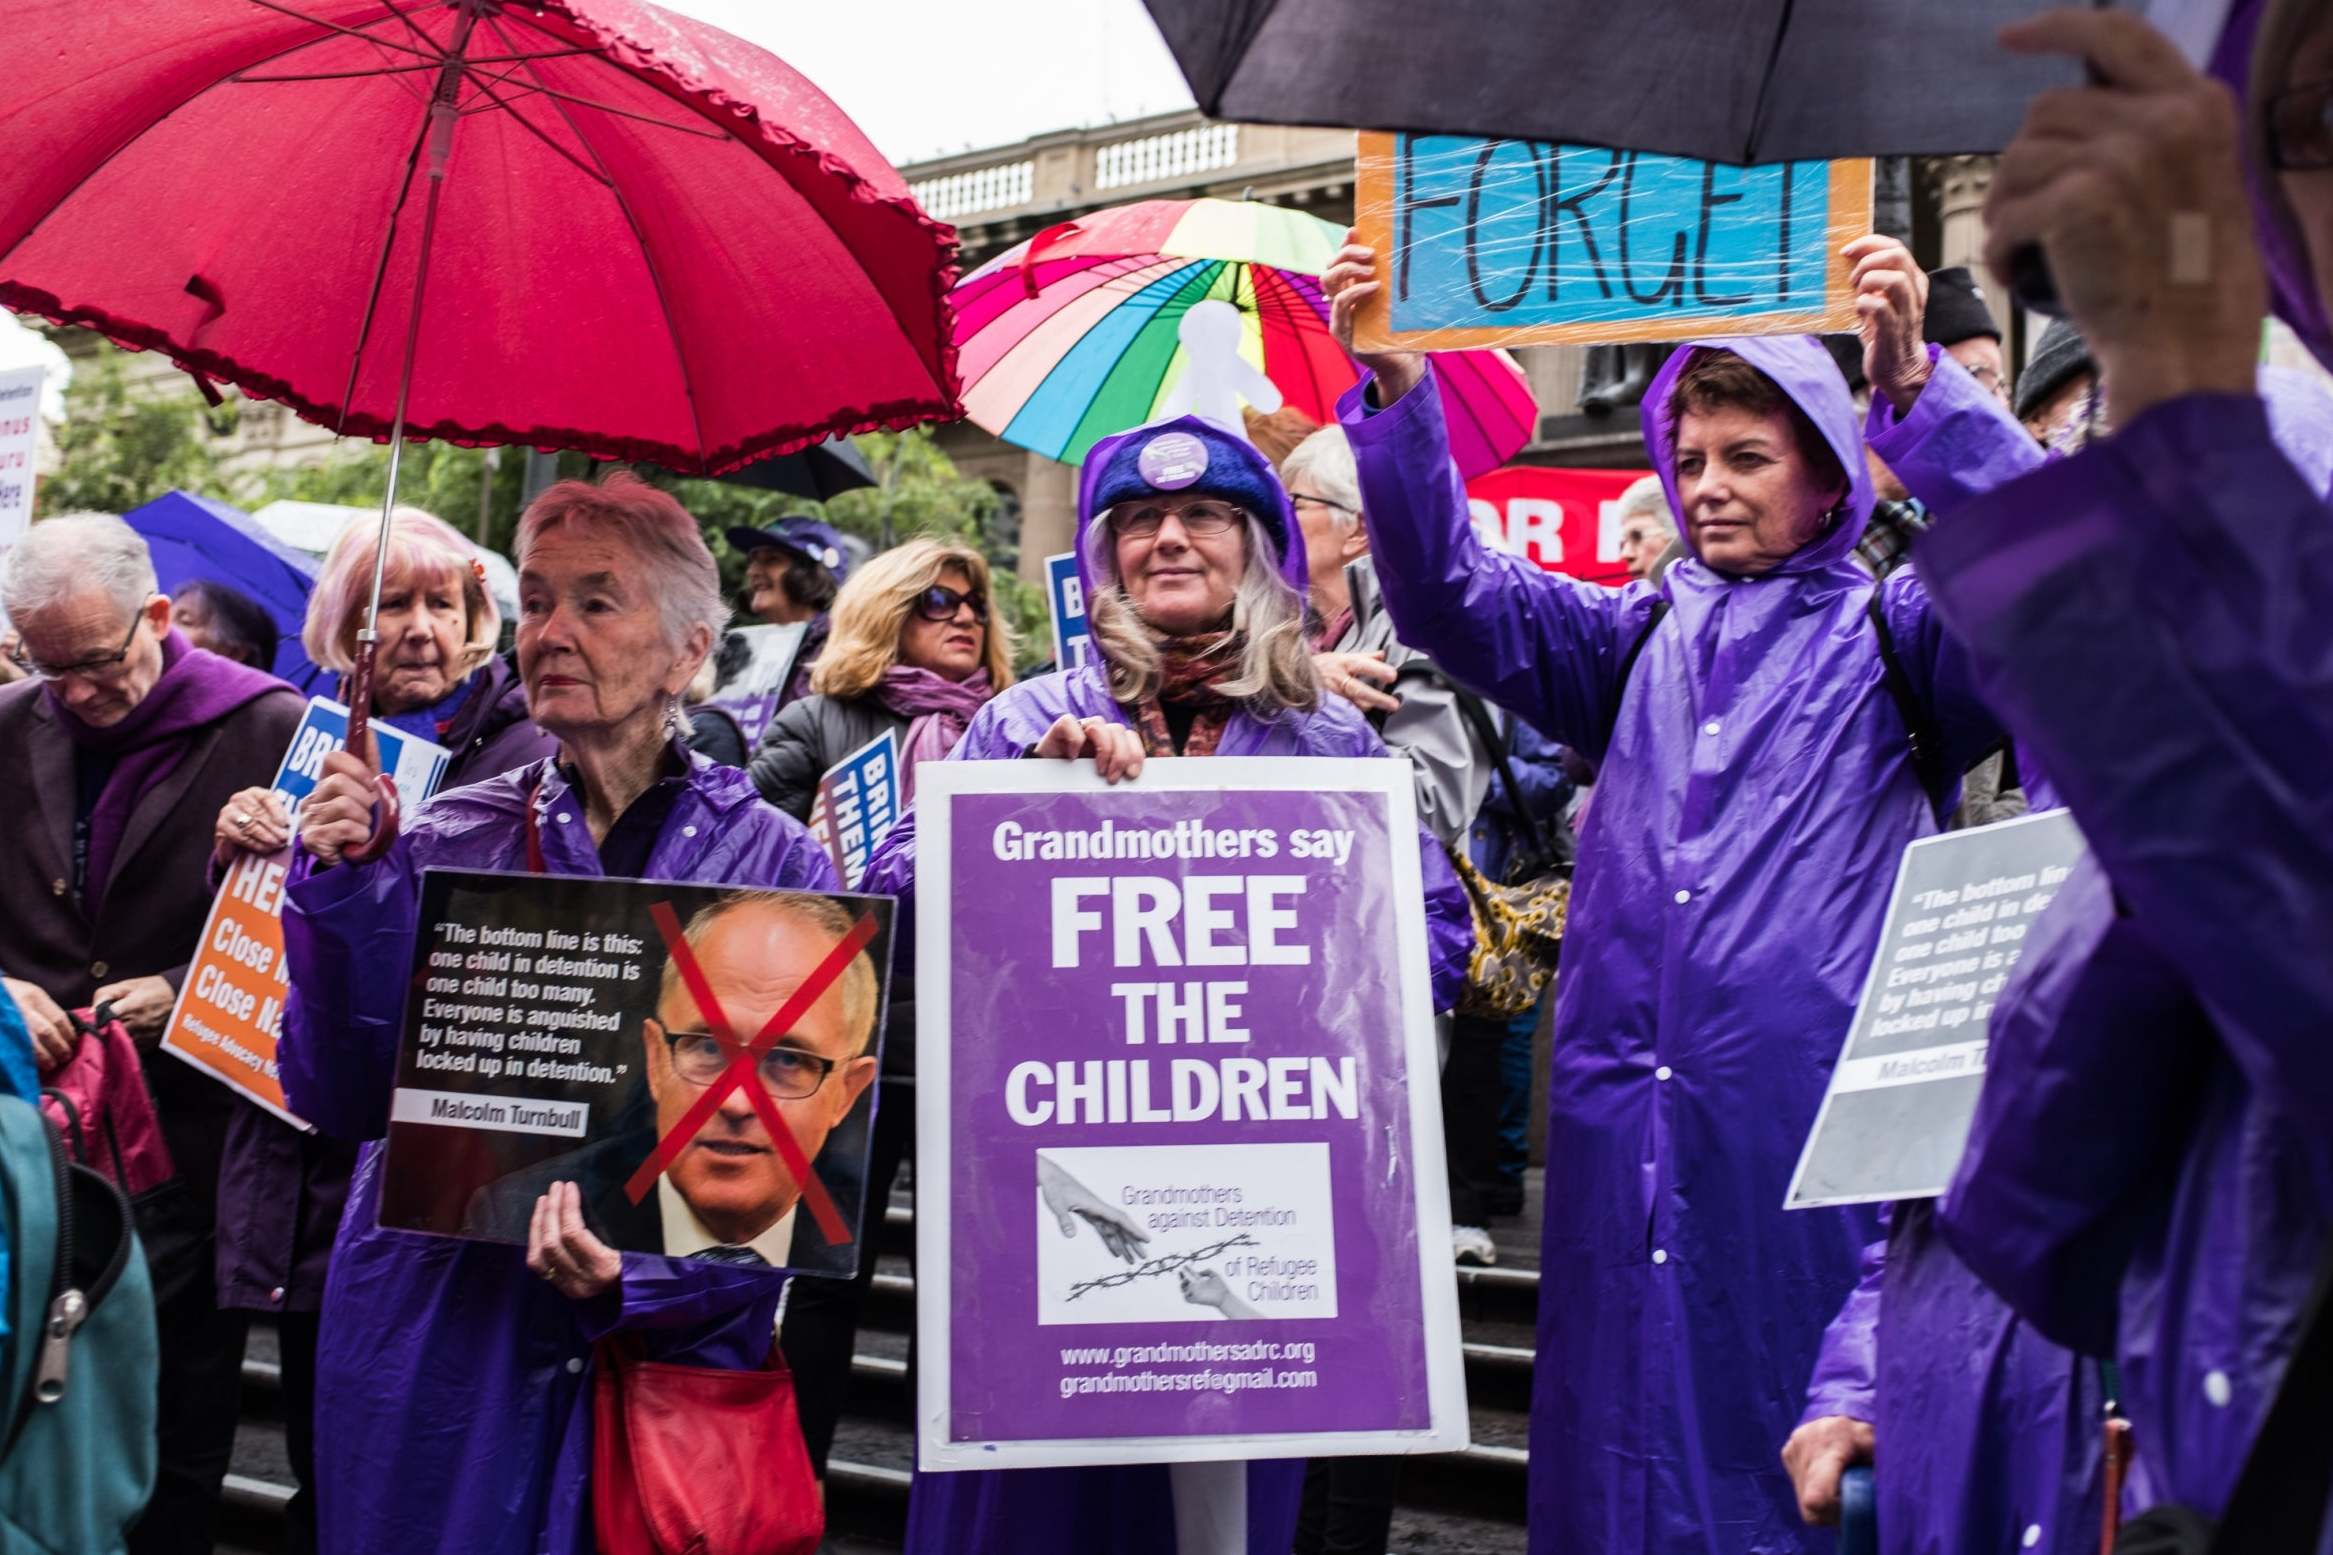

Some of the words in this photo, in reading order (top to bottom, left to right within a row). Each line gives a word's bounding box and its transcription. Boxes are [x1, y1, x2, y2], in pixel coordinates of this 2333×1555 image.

[993, 819, 1279, 861] Grandmothers
[1289, 828, 1356, 866] say
[1960, 873, 2036, 902] bottom
[1051, 875, 1311, 968] FREE
[1902, 917, 1940, 938] one
[1942, 902, 1996, 929] child
[1997, 899, 2020, 918] in
[212, 917, 274, 974] Close
[480, 925, 541, 949] bottom
[545, 930, 579, 950] line
[583, 932, 599, 953] is
[603, 934, 644, 955] this:
[1895, 942, 1932, 962] one
[1934, 927, 1989, 955] child
[1990, 924, 2026, 944] too
[429, 952, 463, 968] one
[465, 951, 509, 973] child
[513, 954, 531, 974] in
[534, 957, 619, 980] detention
[622, 961, 641, 981] is
[1887, 957, 1980, 988] Everyone
[1982, 951, 2003, 970] is
[195, 964, 255, 1022] Close
[426, 977, 459, 994] one
[462, 976, 507, 998] child
[510, 979, 539, 999] too
[542, 985, 597, 1006] many.
[1877, 993, 1906, 1015] by
[1907, 981, 1979, 1008] having
[423, 998, 502, 1025] Everyone
[506, 1004, 523, 1024] is
[526, 1010, 622, 1033] anguished
[1111, 981, 1250, 1045] THE
[1869, 1008, 1940, 1037] locked
[1940, 1007, 1970, 1028] up
[181, 1013, 221, 1045] Refugee
[419, 1024, 442, 1048] by
[445, 1025, 505, 1053] having
[508, 1030, 582, 1055] children
[416, 1049, 476, 1073] locked
[478, 1059, 501, 1078] up
[506, 1056, 524, 1077] in
[1878, 1054, 1965, 1081] Malcolm
[1005, 1057, 1359, 1126] CHILDREN
[431, 1098, 505, 1121] Malcolm
[510, 1105, 581, 1130] Turnbull
[1122, 1185, 1243, 1206] Grandmothers
[1148, 1208, 1210, 1232] against
[1215, 1206, 1297, 1228] Detention
[1224, 1257, 1243, 1277] of
[1247, 1256, 1317, 1278] Refugee
[1248, 1281, 1319, 1301] Children
[1060, 1339, 1316, 1368] www.grandmothersadrc.org
[1060, 1368, 1317, 1398] grandmothersref@gmail.com
